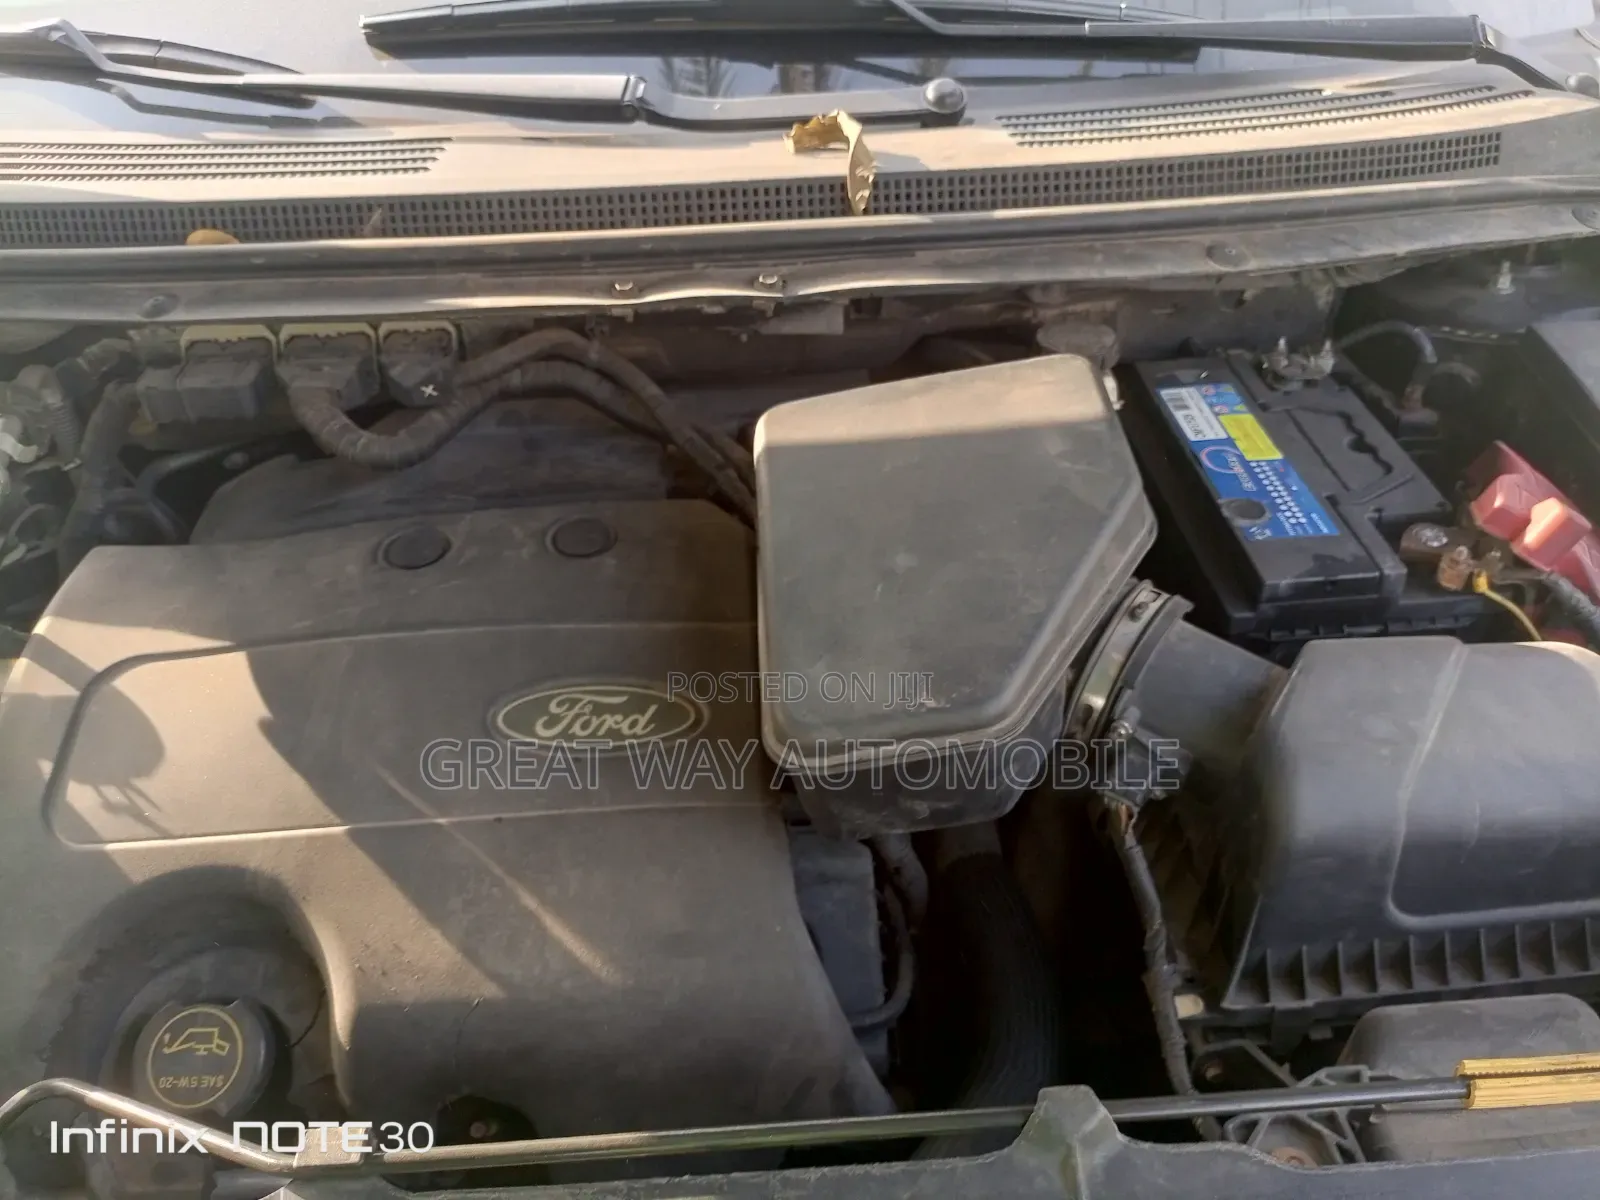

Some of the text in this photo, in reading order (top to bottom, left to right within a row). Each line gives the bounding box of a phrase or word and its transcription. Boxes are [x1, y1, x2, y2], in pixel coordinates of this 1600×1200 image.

[534, 693, 659, 737] Ford
[158, 1074, 225, 1090] SAE 5W-20
